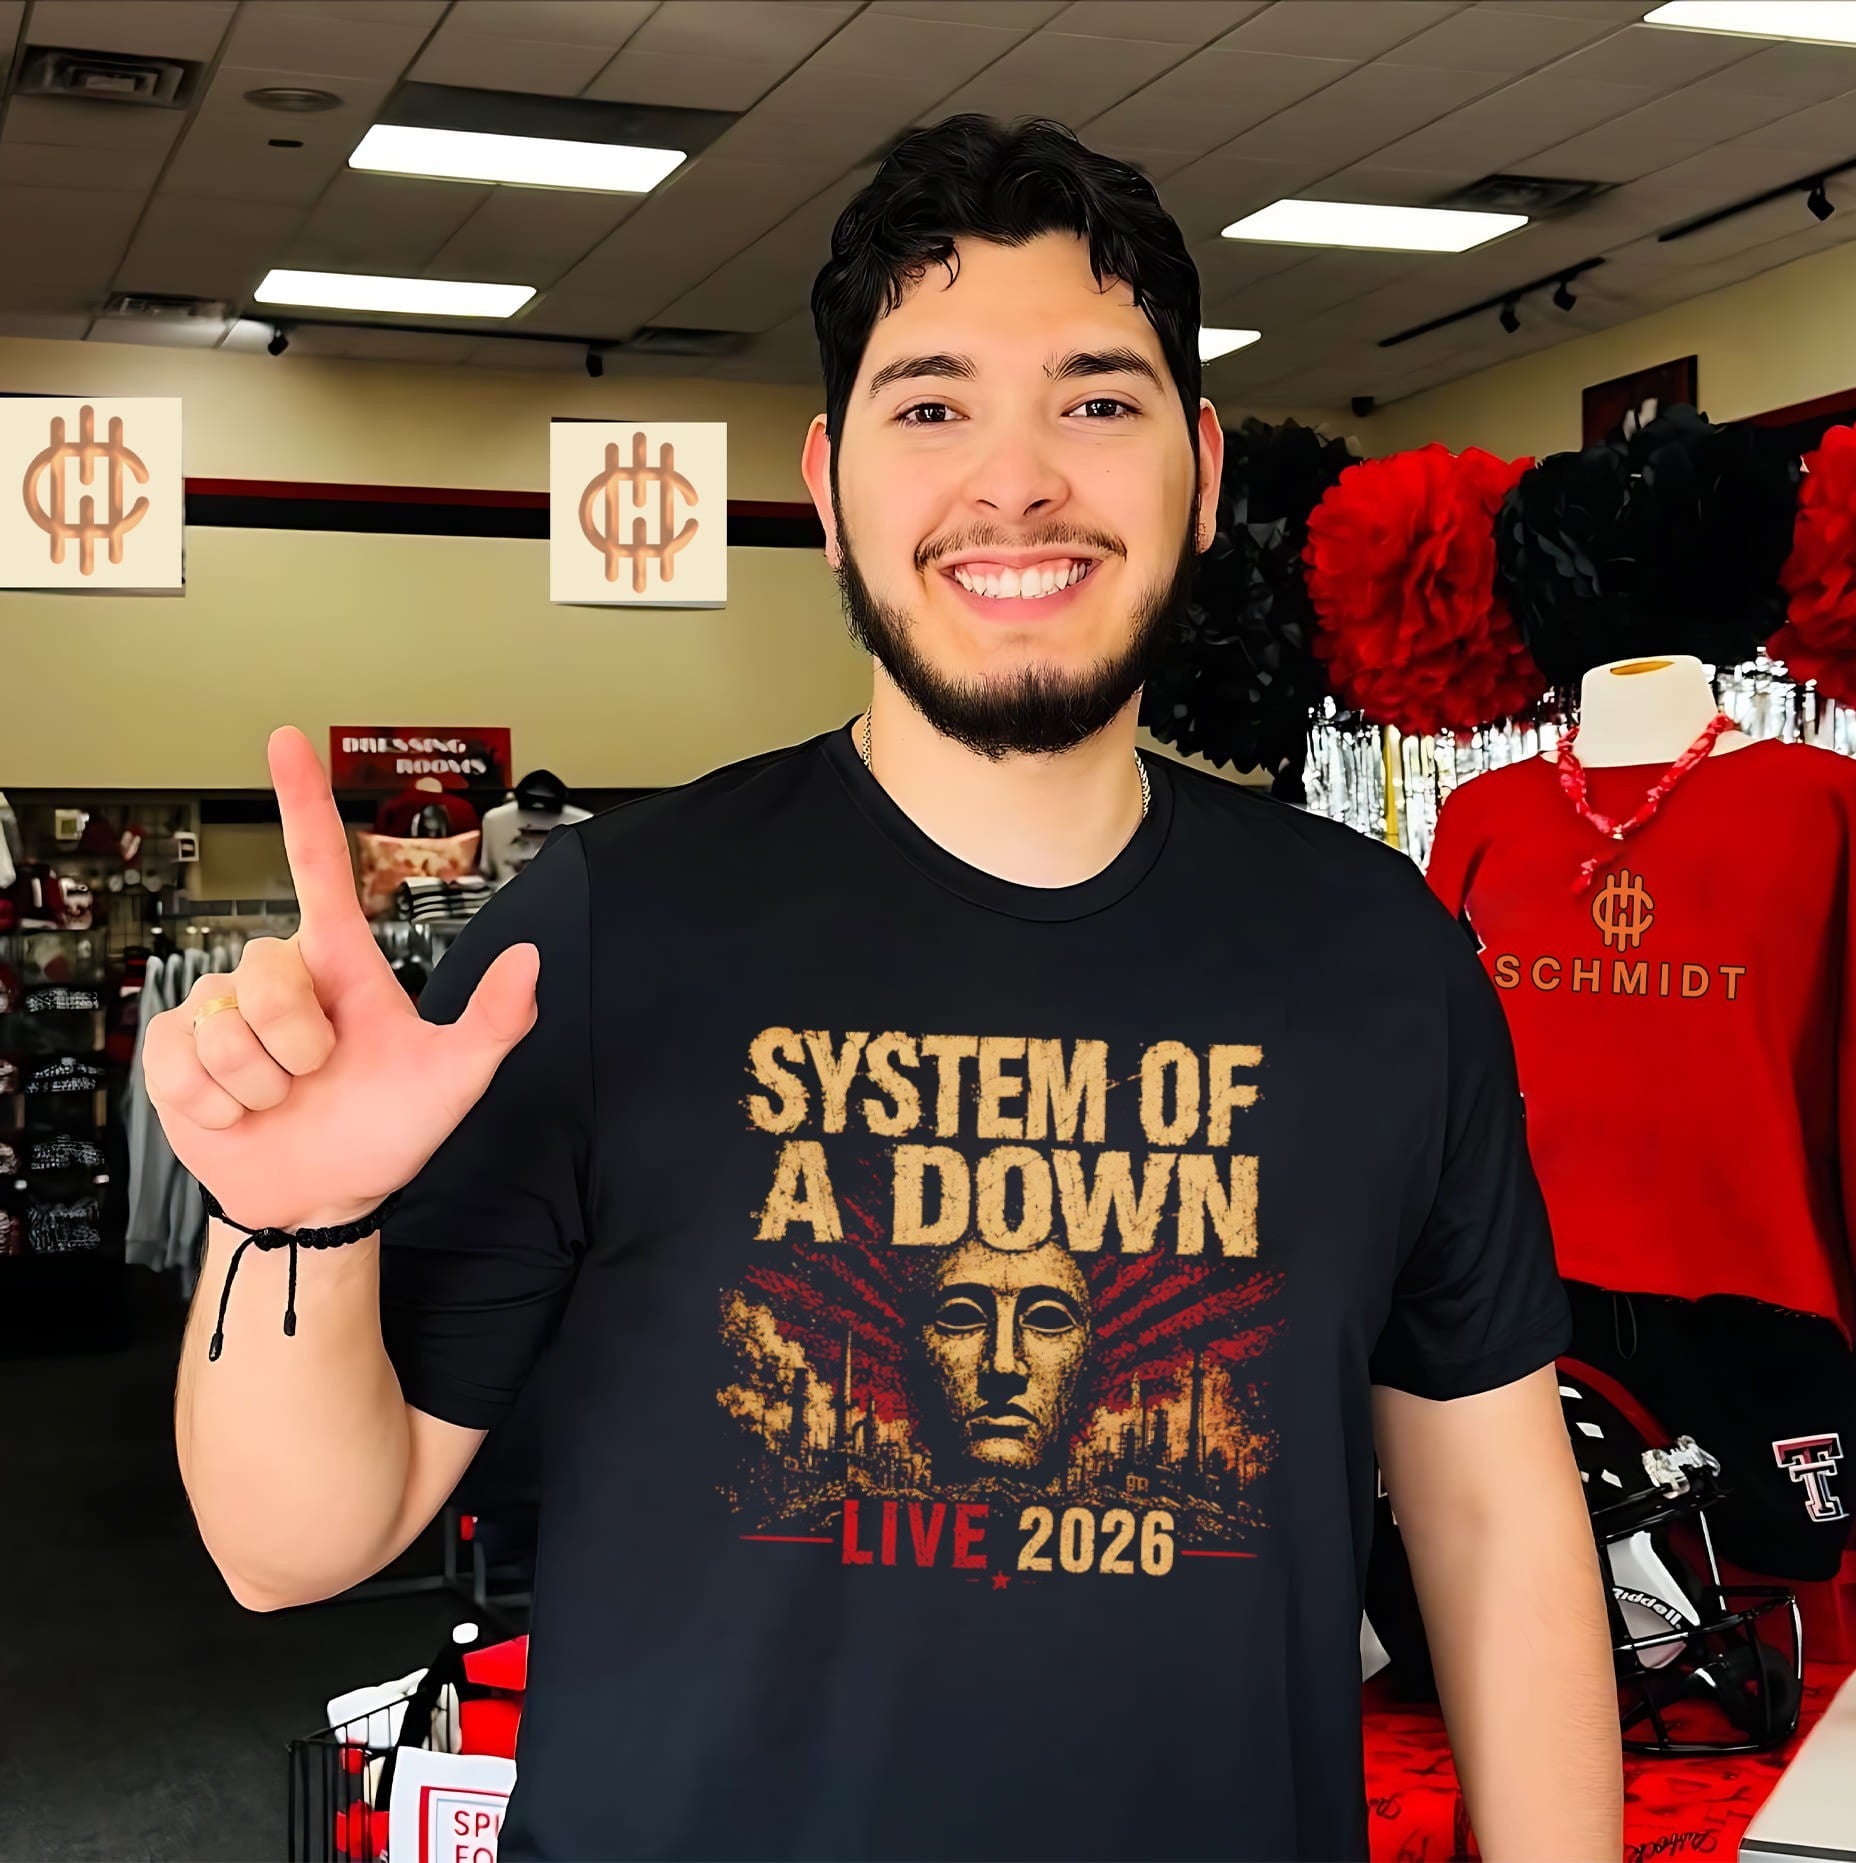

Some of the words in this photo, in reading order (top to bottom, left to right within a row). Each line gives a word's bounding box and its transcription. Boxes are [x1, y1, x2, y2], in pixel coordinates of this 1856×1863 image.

[396, 758, 487, 775] ROOMS
[1494, 955, 1747, 1000] SCHMIDT
[746, 1026, 1108, 1143] SYSTEM
[1139, 1040, 1263, 1147] OF
[752, 1140, 845, 1242] A
[891, 1143, 1260, 1258] DOWN
[841, 1500, 989, 1569] LIVE
[1016, 1506, 1175, 1577] 2026
